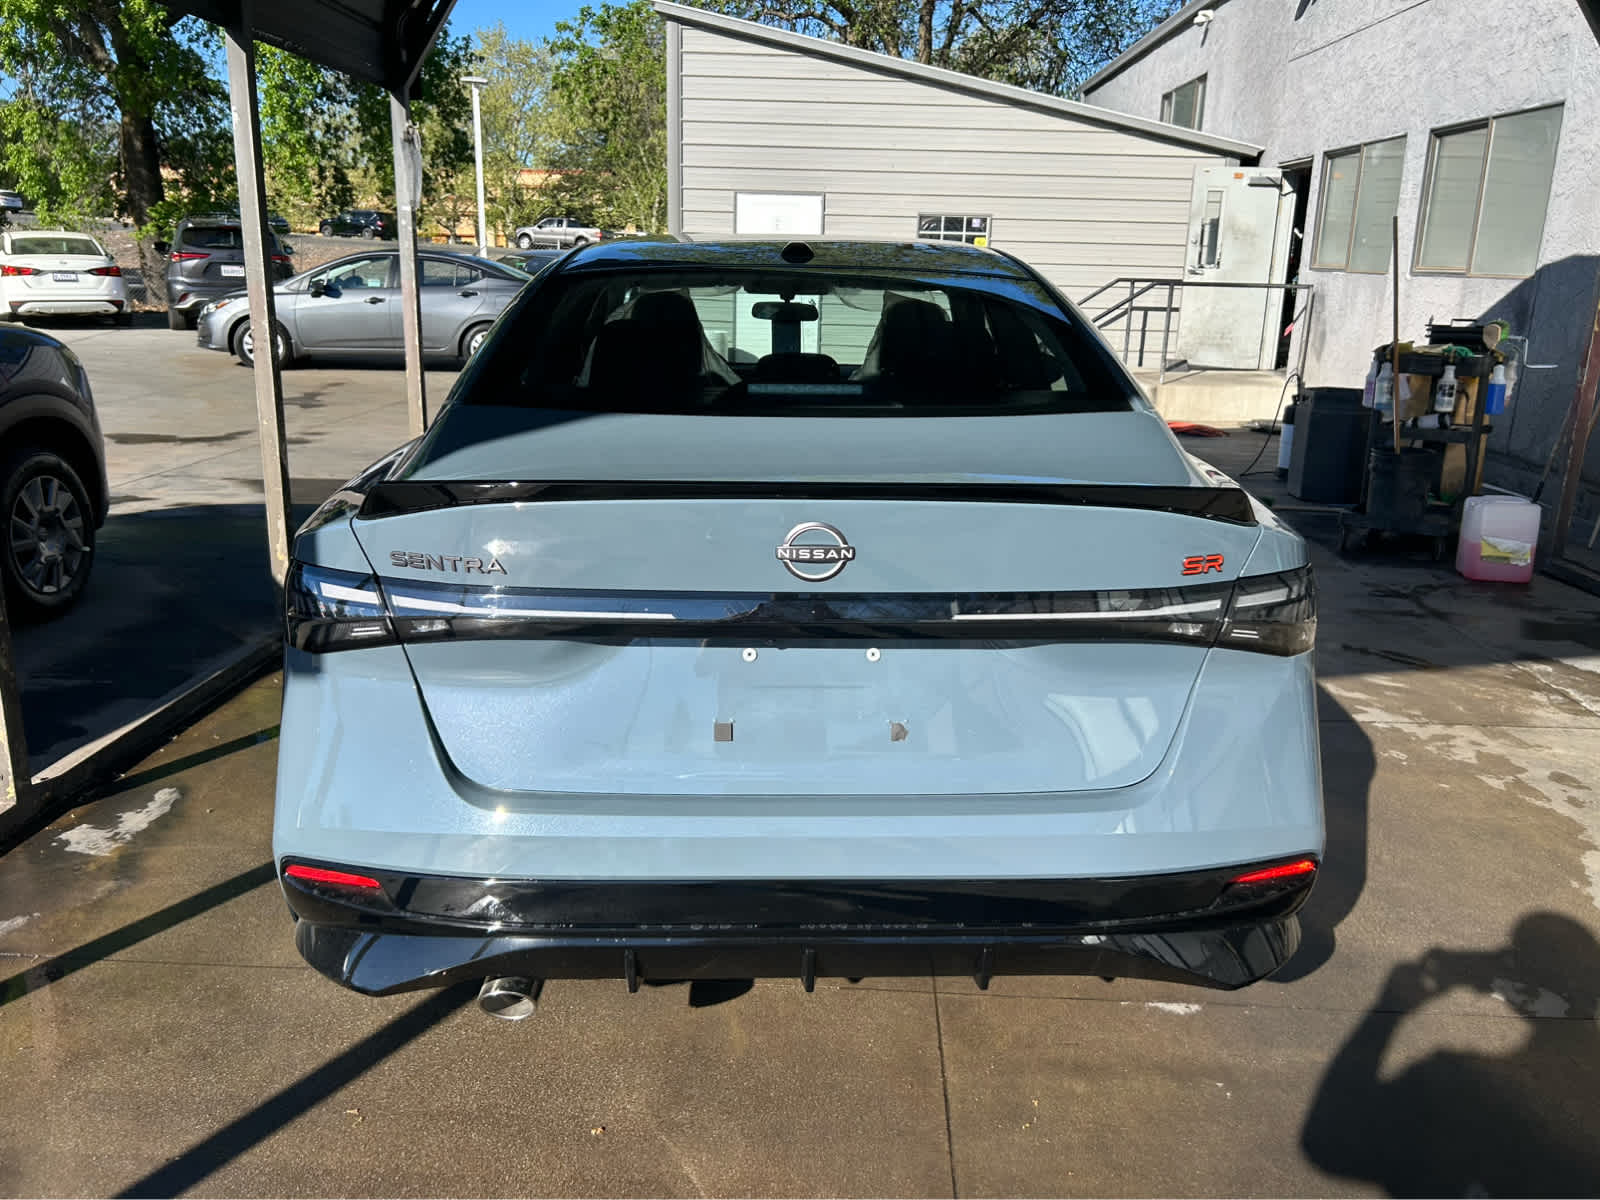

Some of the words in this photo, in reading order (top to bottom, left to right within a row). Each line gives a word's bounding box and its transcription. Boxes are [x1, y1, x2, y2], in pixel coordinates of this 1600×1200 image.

[390, 550, 508, 575] SENTRA
[777, 548, 853, 559] NISSAN
[1182, 553, 1224, 576] SR
